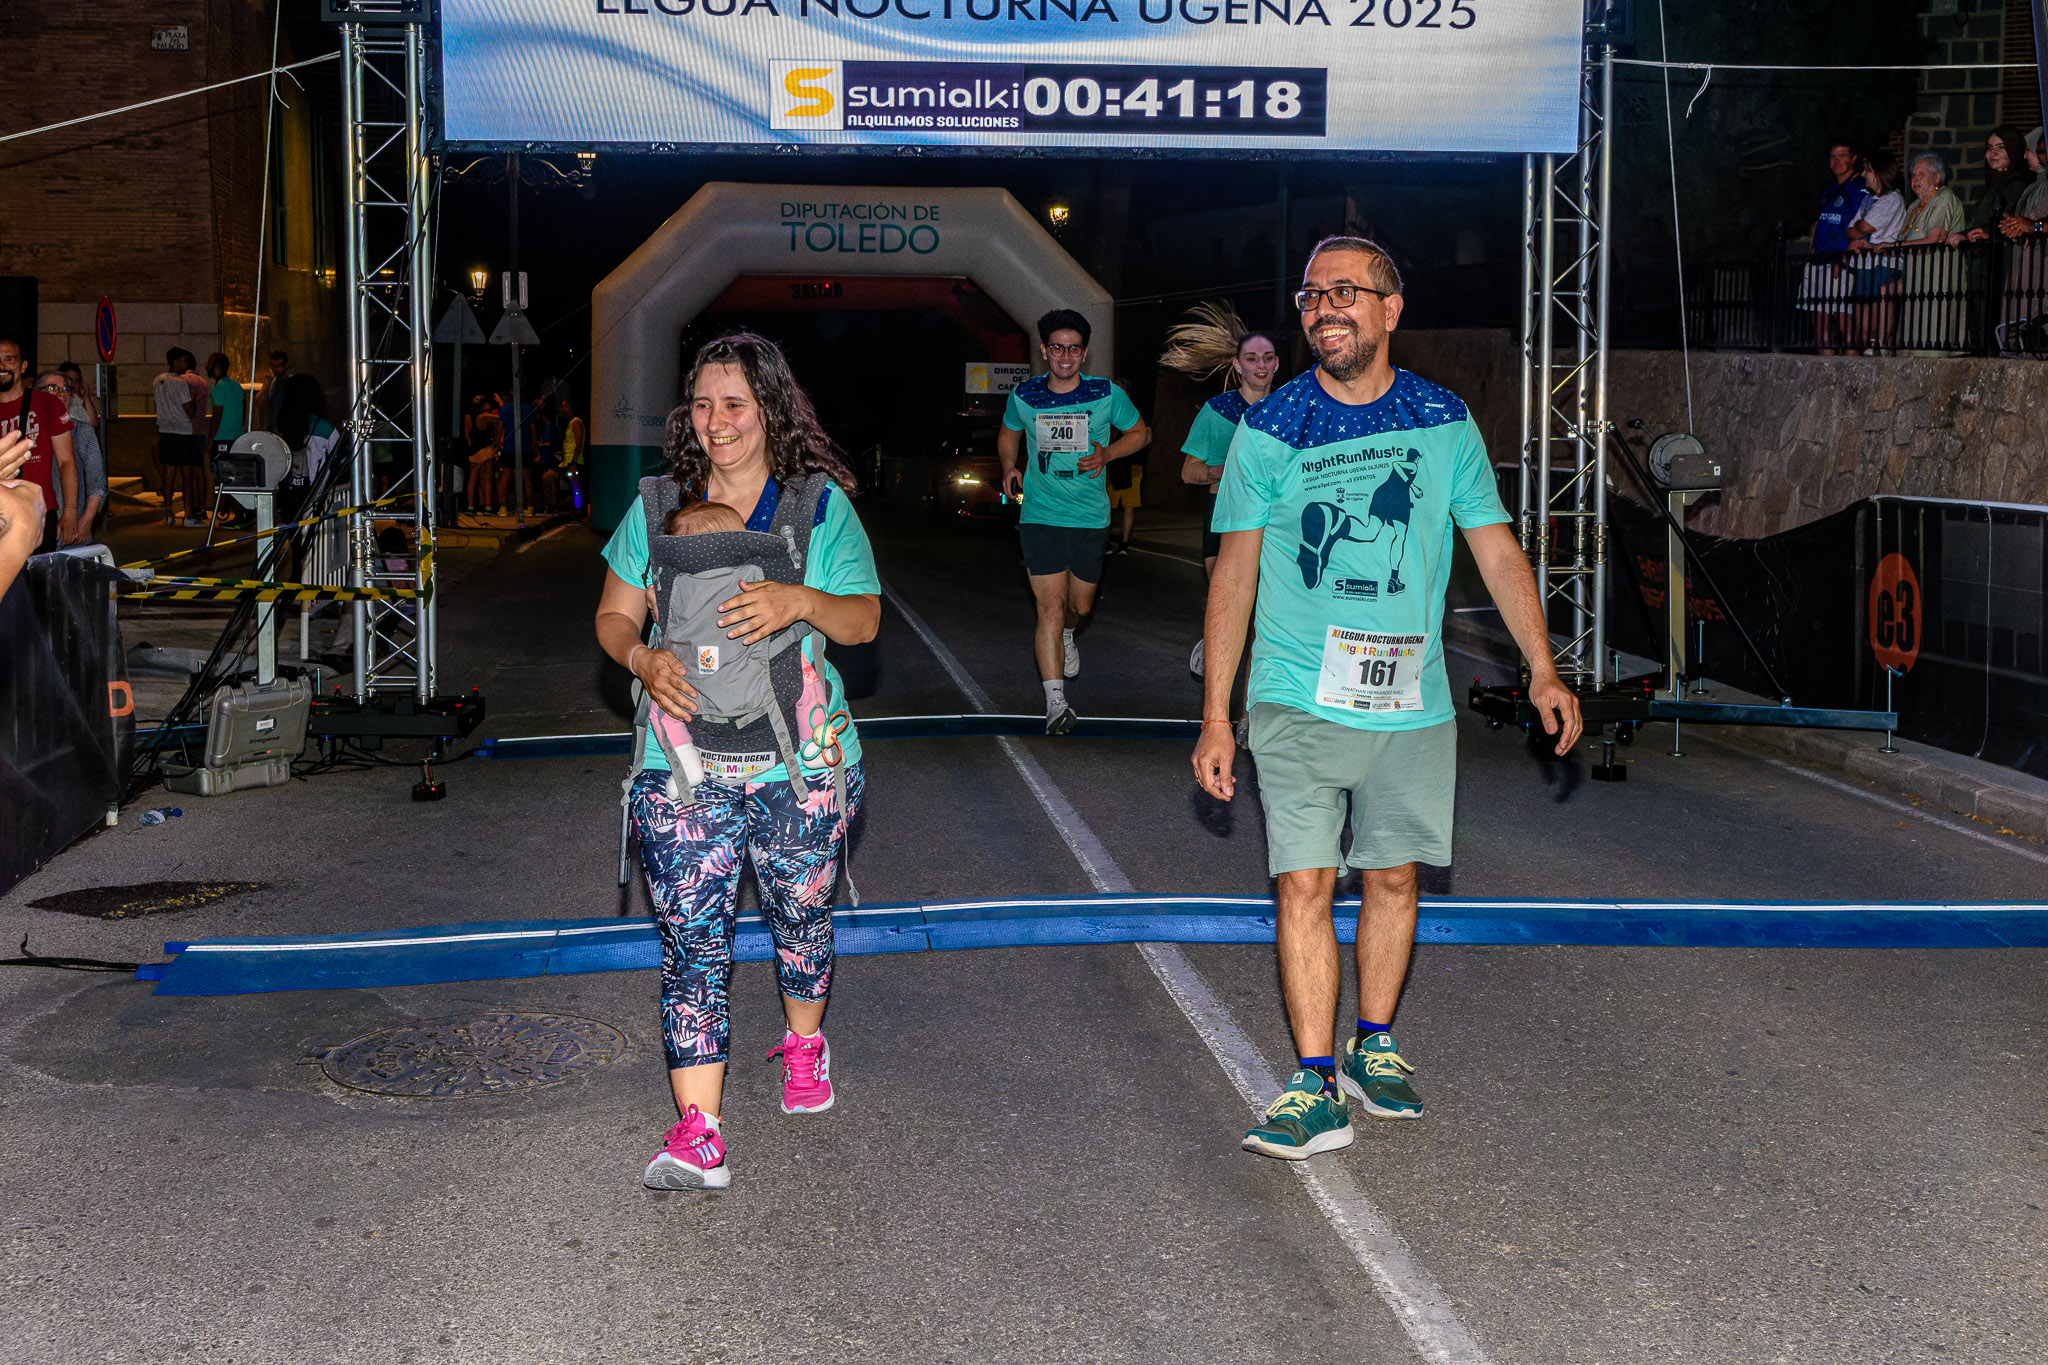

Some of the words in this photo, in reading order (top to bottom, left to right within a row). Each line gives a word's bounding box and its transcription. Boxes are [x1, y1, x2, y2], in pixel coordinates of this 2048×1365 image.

[1349, 0, 1477, 29] 2025
[848, 80, 1020, 109] sumialki
[1024, 77, 1302, 119] 00:41:18
[848, 115, 934, 127] ALQUILAMOS
[937, 116, 1019, 128] SOLUCIONES
[781, 202, 907, 221] DIPUTACIÓN
[914, 206, 939, 221] DE
[781, 222, 940, 254] TOLEDO
[1050, 426, 1073, 440] 240
[1302, 446, 1404, 474] NightRunMusic
[1877, 580, 1914, 653] e3
[1340, 630, 1365, 642] LEGUA
[1366, 634, 1404, 645] NOCTURNA
[1359, 659, 1398, 687] 161
[701, 752, 743, 763] NOCTURNA
[744, 754, 770, 763] UGENA
